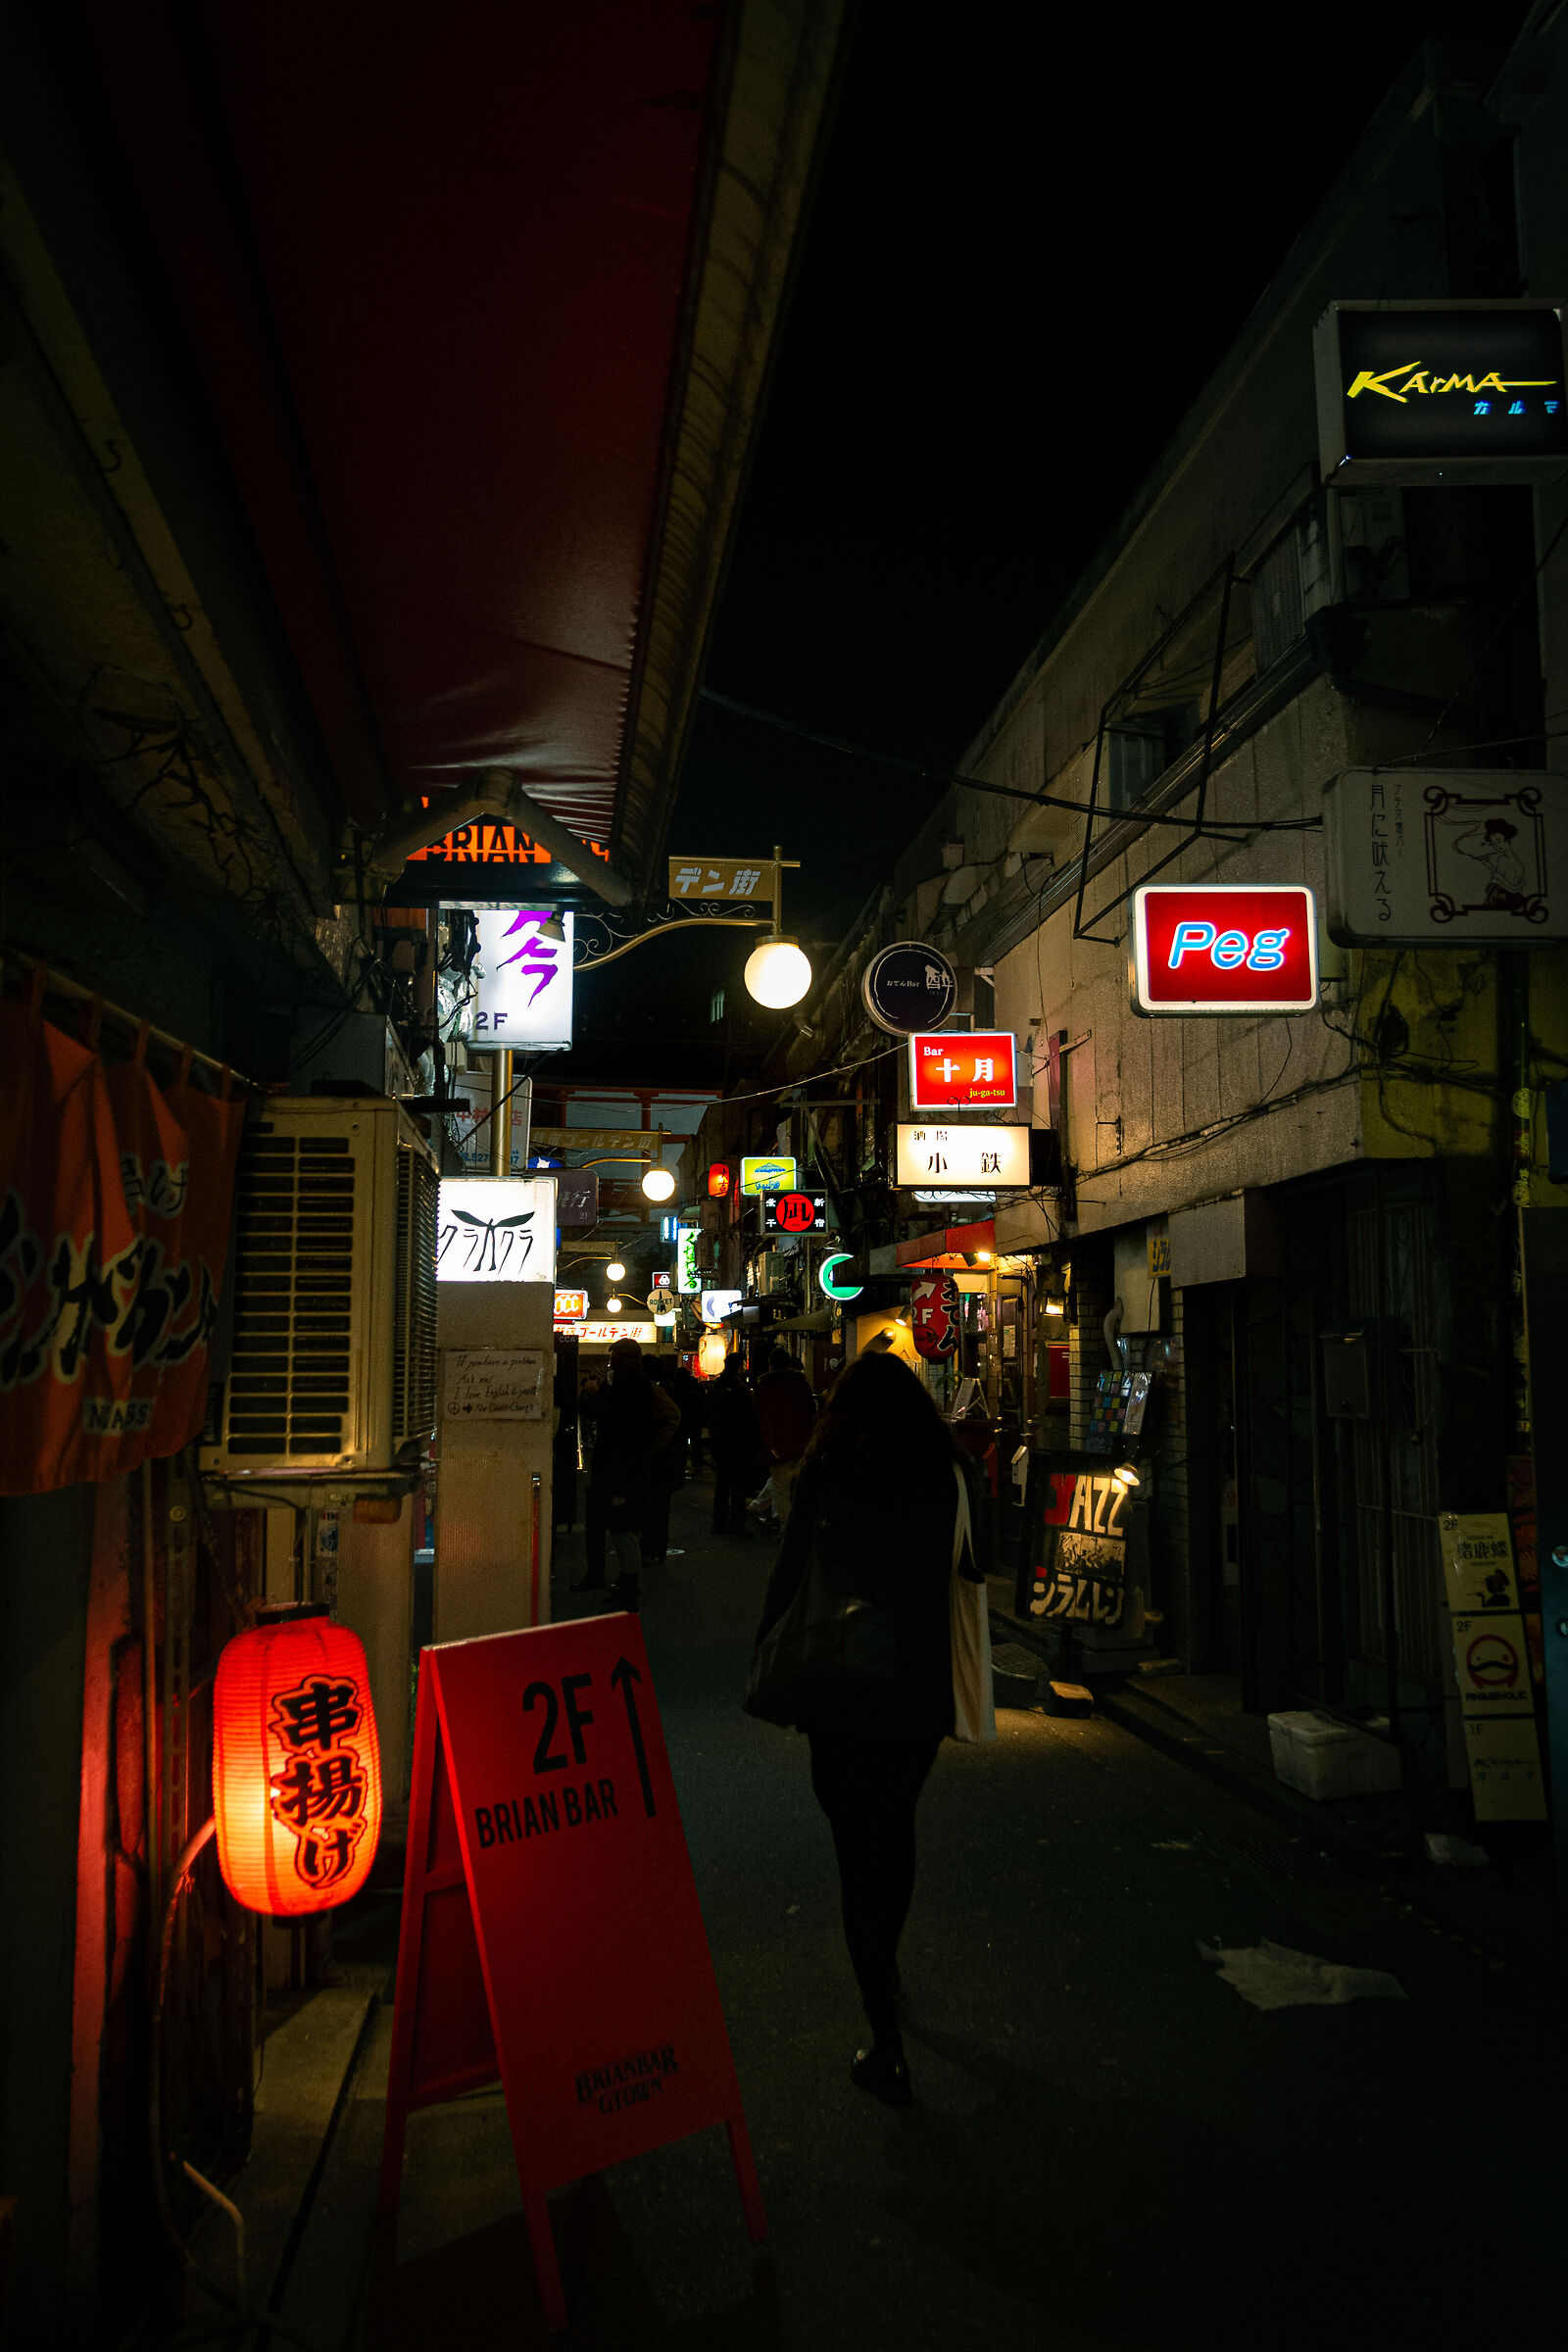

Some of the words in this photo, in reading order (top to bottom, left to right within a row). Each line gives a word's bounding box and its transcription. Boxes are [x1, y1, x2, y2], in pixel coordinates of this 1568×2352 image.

[1371, 784, 1392, 921] 月に吠える
[674, 866, 762, 897] デン街
[1167, 921, 1292, 972] Peg
[474, 1011, 508, 1030] 2F
[923, 1046, 944, 1056] Bar
[935, 1057, 995, 1083] 十月
[968, 1088, 1005, 1099] ju-ga-tsu
[926, 1152, 1003, 1174] 小鉄
[1043, 1473, 1128, 1539] JAZZ
[1444, 1520, 1458, 1531] 2F
[1456, 1621, 1472, 1633] 2F
[521, 1672, 594, 1774] 2F
[1471, 1724, 1484, 1736] 1F
[475, 1792, 561, 1849] BRIAN
[563, 1779, 619, 1829] BAR
